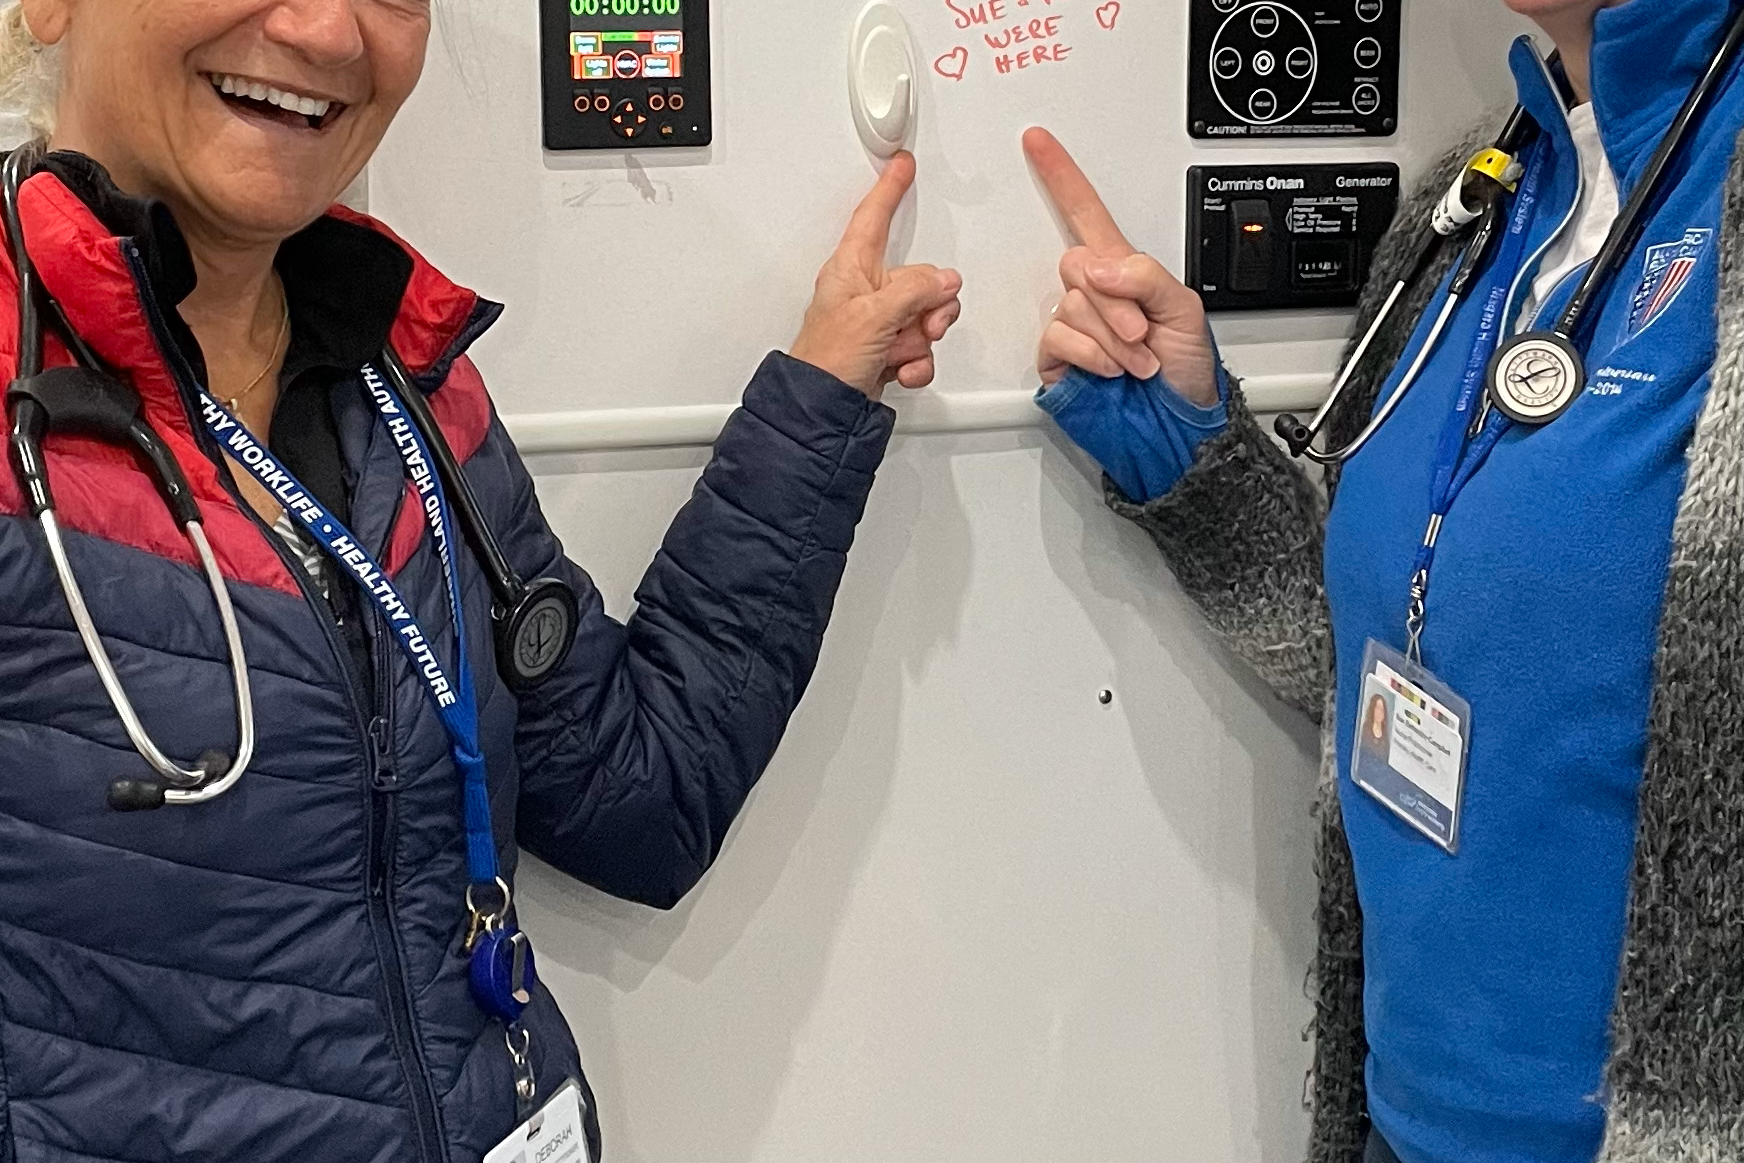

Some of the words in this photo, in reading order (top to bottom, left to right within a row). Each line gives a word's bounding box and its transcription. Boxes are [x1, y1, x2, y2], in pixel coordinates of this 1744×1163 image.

[984, 15, 1064, 49] WERE
[995, 43, 1073, 74] HERE
[1208, 176, 1264, 191] Cummins
[1266, 176, 1304, 190] Onan
[1336, 176, 1392, 188] Generator
[362, 363, 400, 415] AUTH
[388, 416, 435, 492] HEALTH
[199, 393, 236, 433] THY
[228, 433, 324, 525] WORKLIFE
[330, 535, 411, 621] HEALTHY
[400, 626, 456, 708] FUTURE
